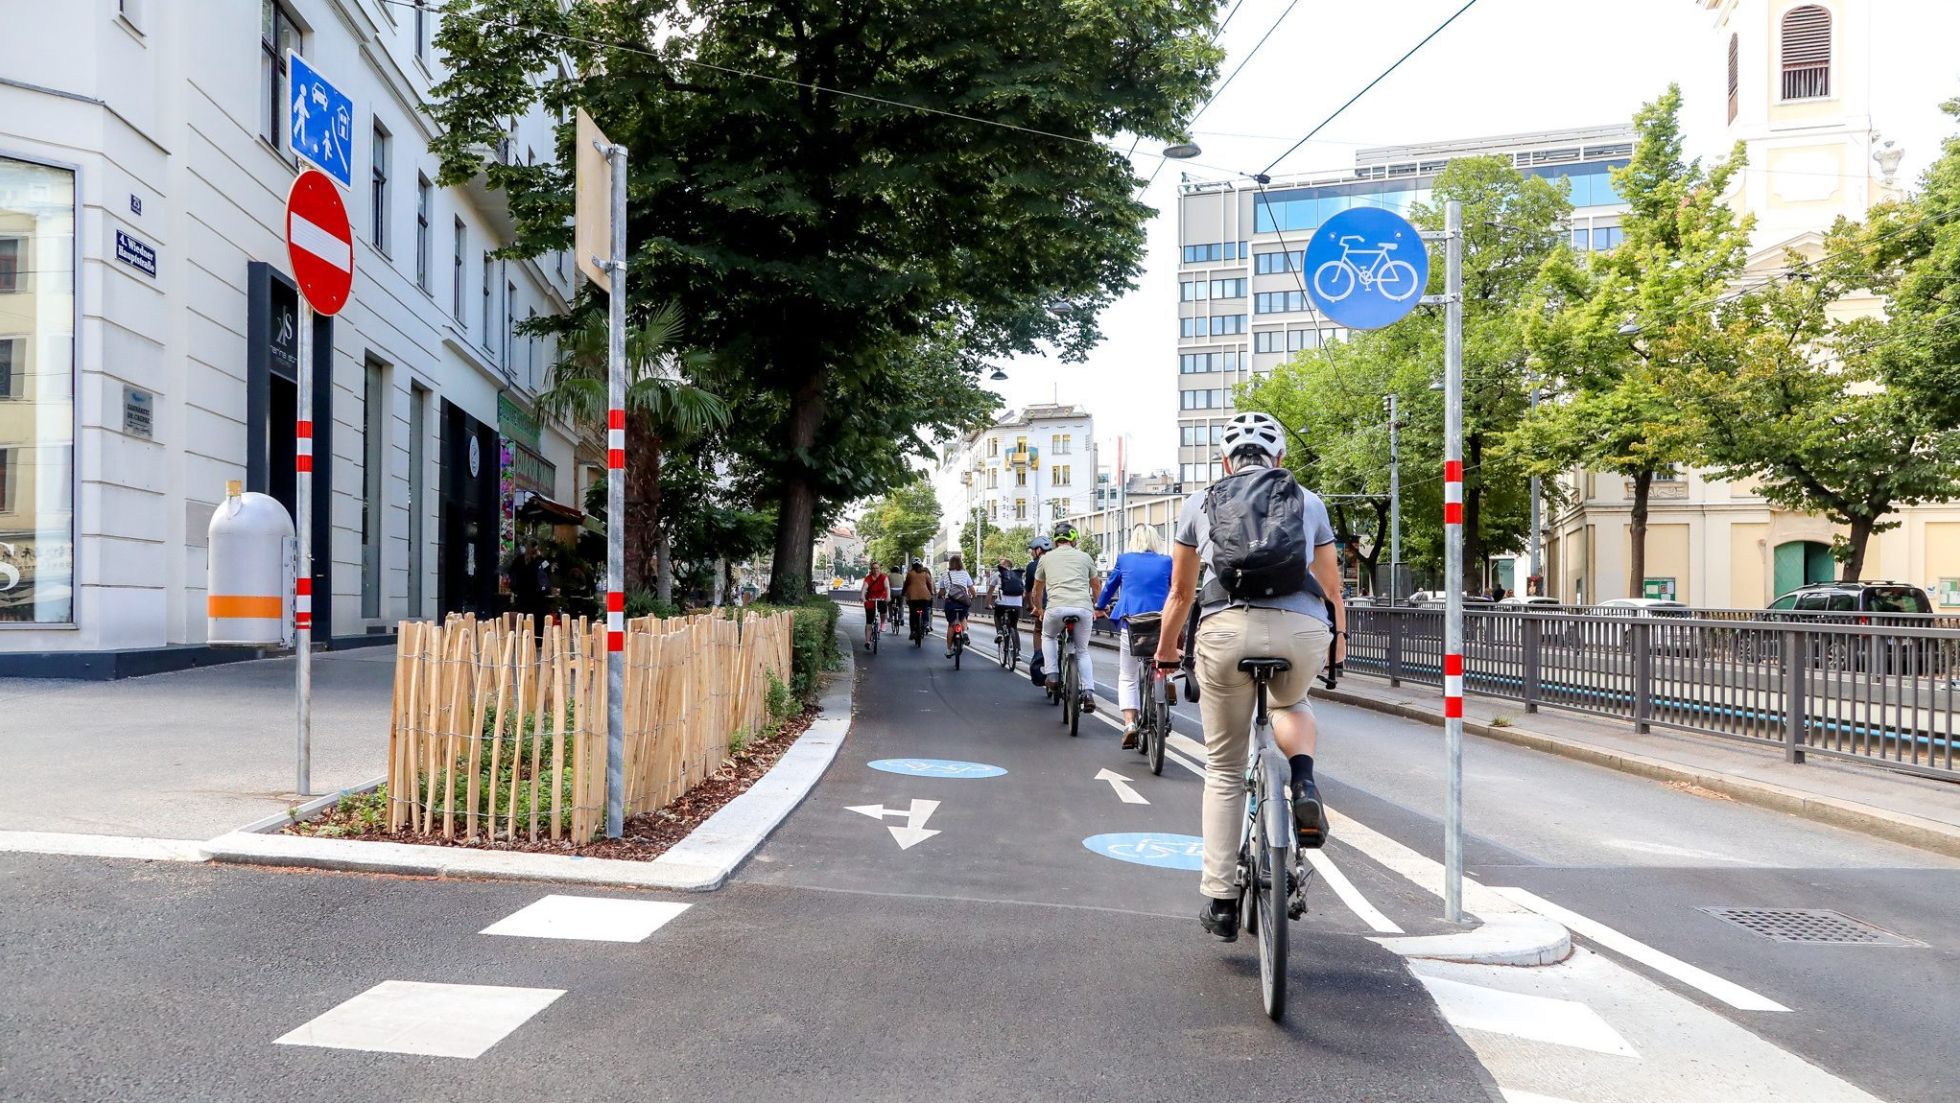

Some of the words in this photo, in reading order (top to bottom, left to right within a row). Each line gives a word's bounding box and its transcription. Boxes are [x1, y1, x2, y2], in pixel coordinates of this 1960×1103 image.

[118, 245, 155, 273] Hauptstraße
[120, 234, 127, 246] 4.
[127, 238, 154, 261] Wiedner
